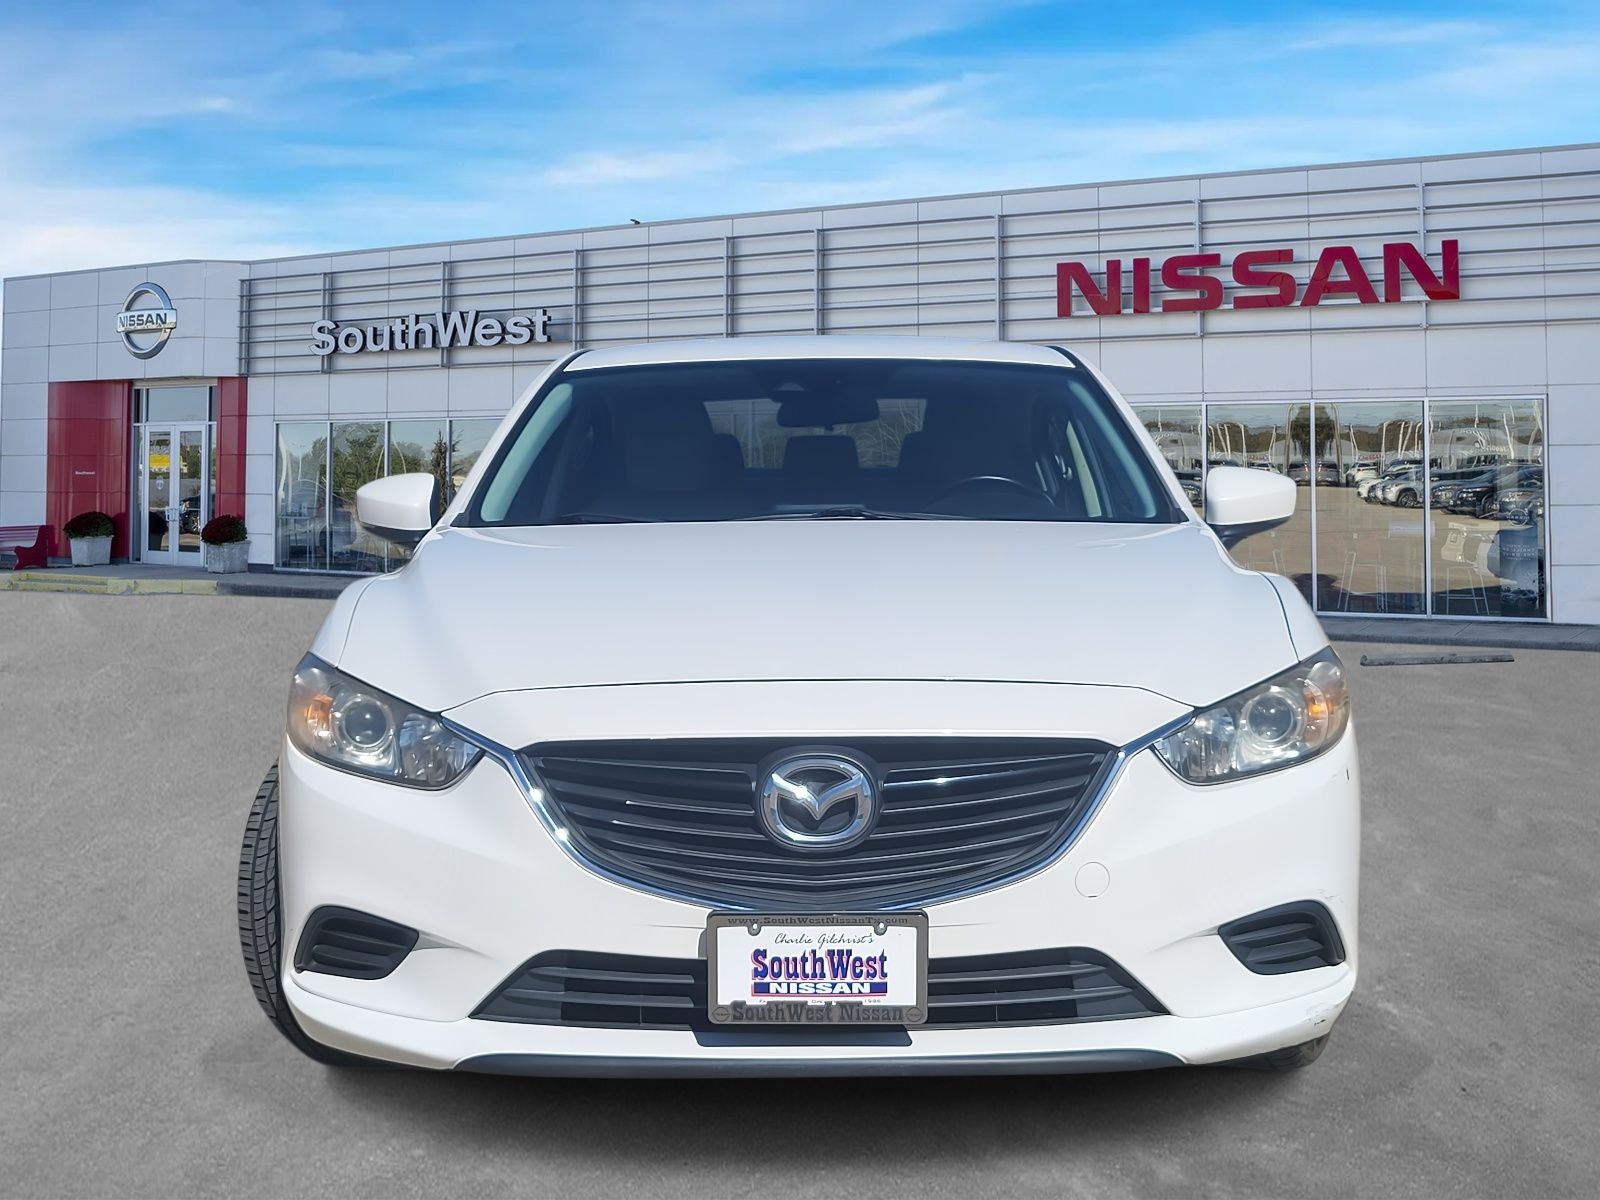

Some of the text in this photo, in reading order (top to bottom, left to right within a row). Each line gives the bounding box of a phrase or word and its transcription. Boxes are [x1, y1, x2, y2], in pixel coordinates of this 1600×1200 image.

[1056, 239, 1460, 318] NISSAN
[118, 313, 167, 328] NISSAN
[309, 308, 552, 356] SouthWest
[774, 933, 875, 950] Charlie Gilchrist's
[752, 948, 888, 980] SouthWest
[769, 982, 871, 994] NISSAN
[732, 1002, 904, 1021] SouthWest Nissan
